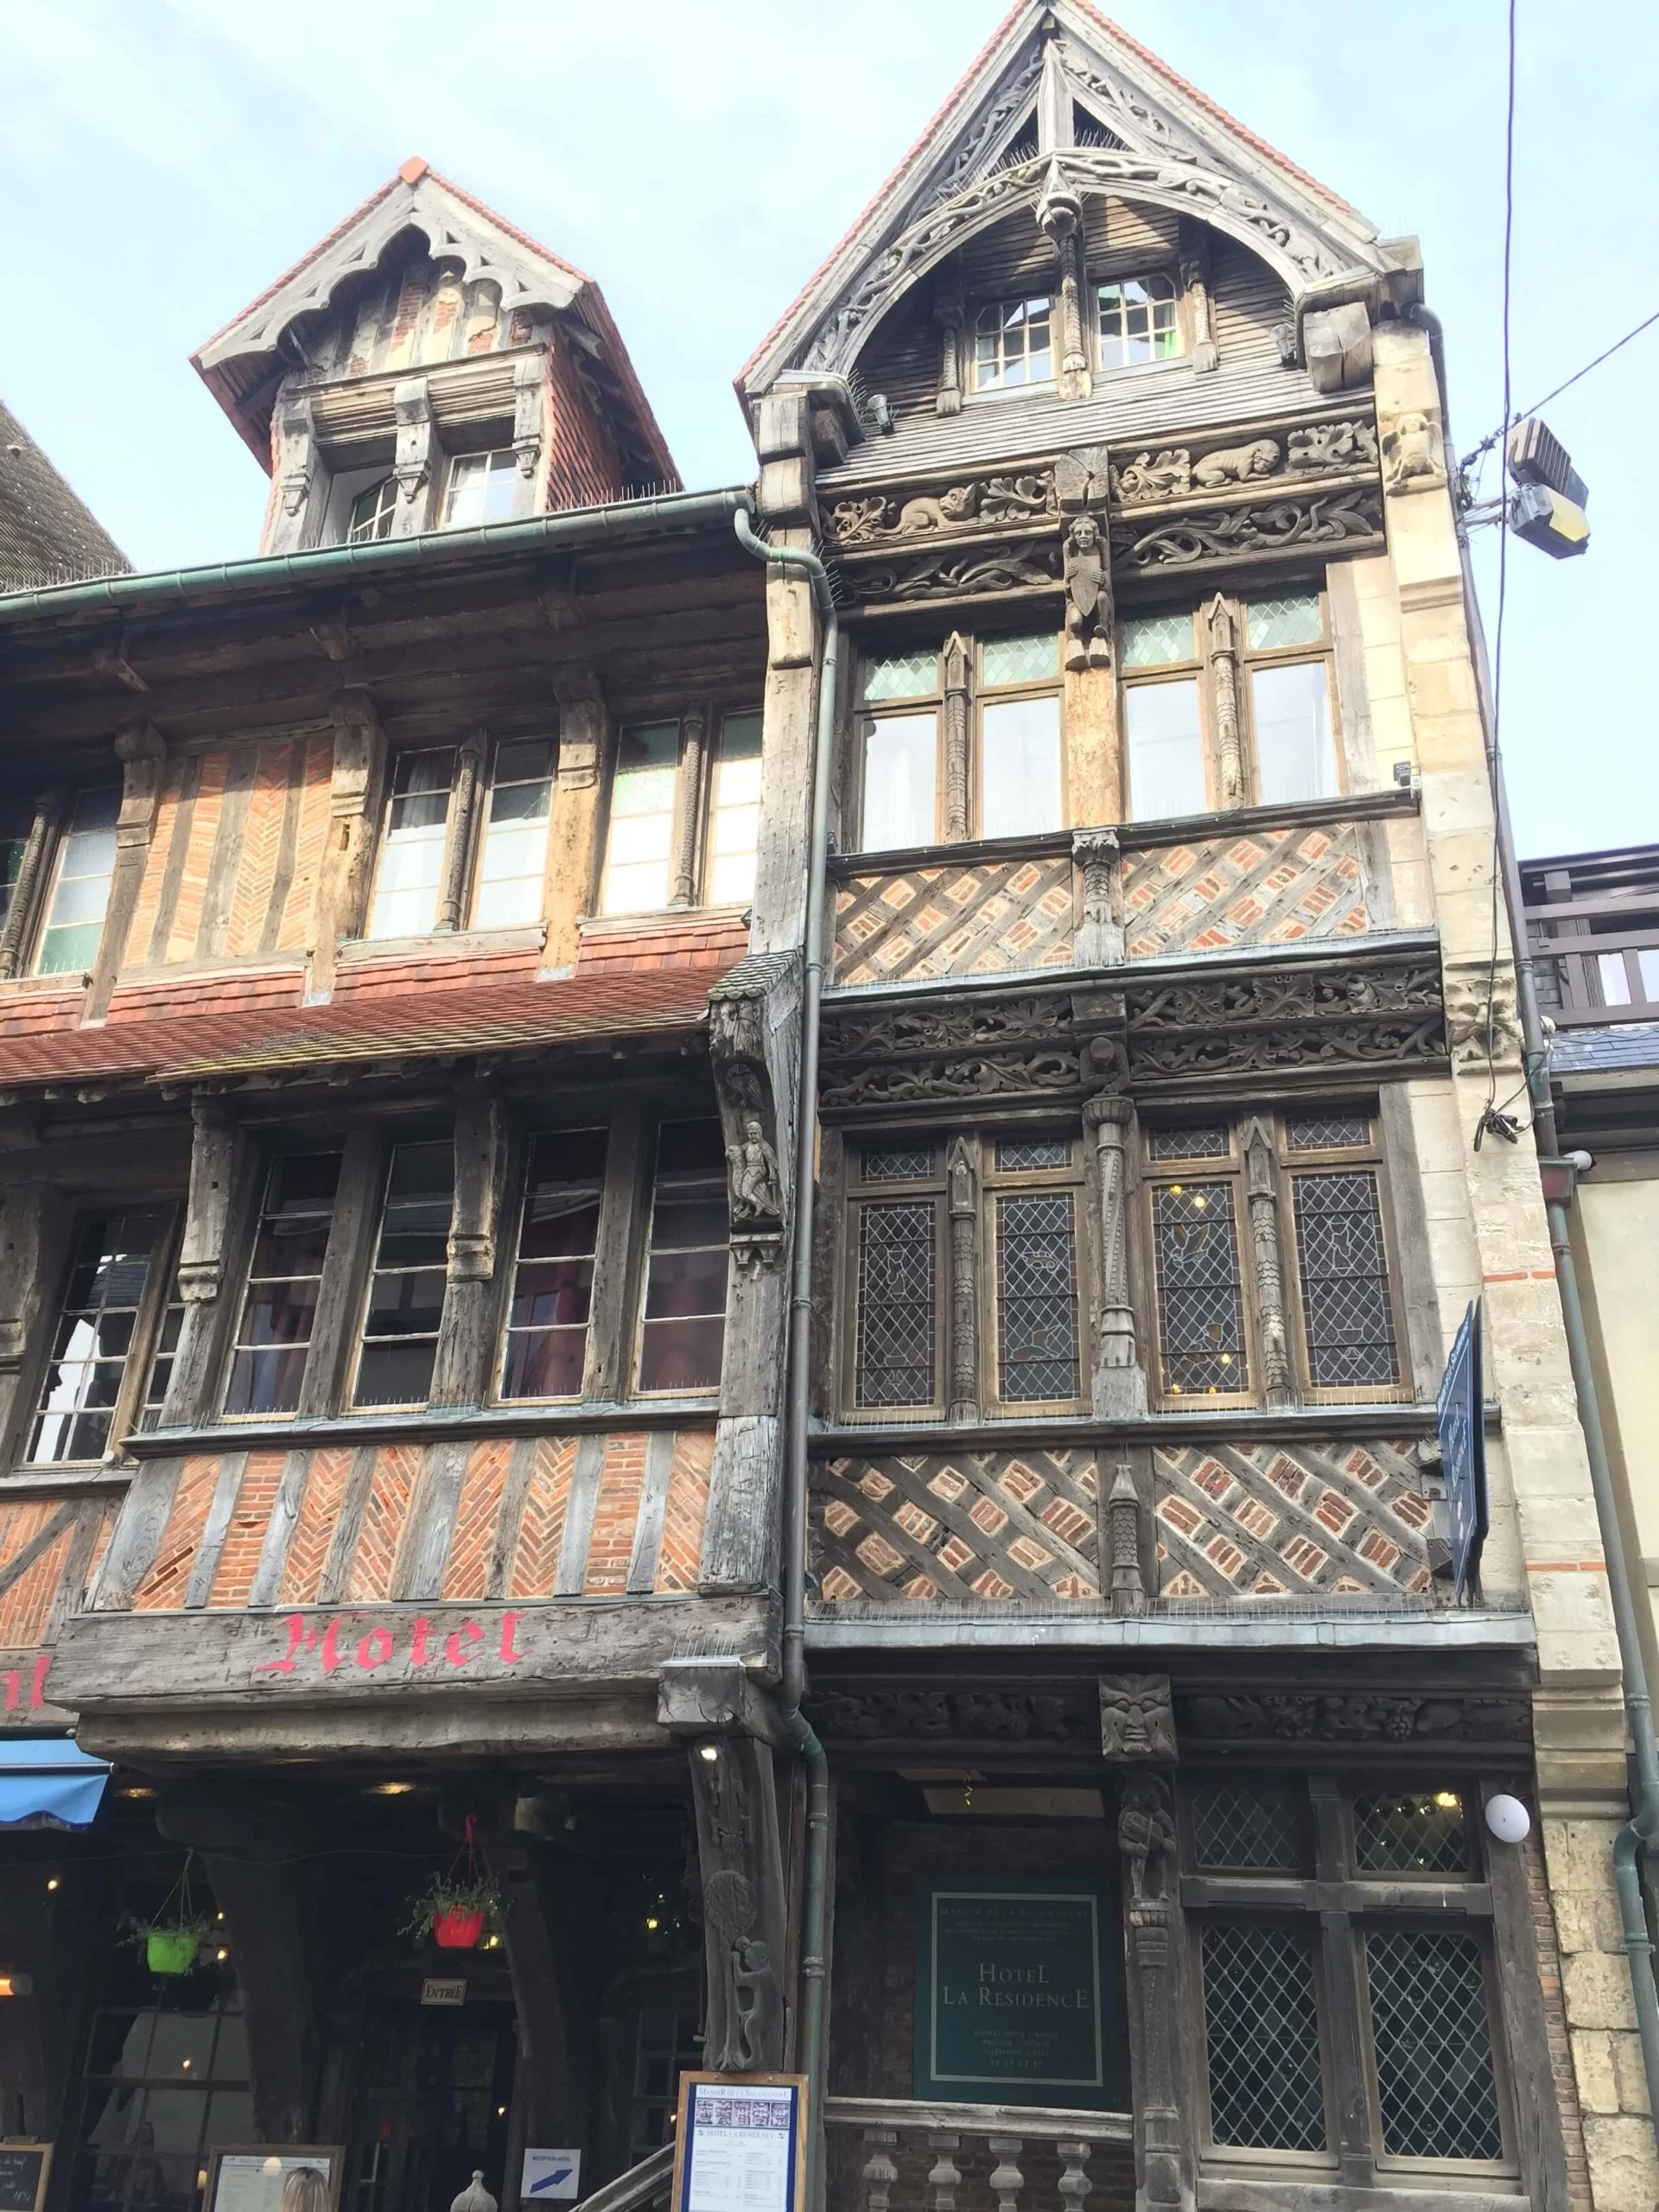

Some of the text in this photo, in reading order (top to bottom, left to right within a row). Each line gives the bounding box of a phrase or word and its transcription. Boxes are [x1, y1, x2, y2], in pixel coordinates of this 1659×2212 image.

[251, 1611, 532, 1675] Hotel
[978, 1962, 1050, 1984] HOTEL
[943, 1985, 1090, 2009] LA RESIDENCE
